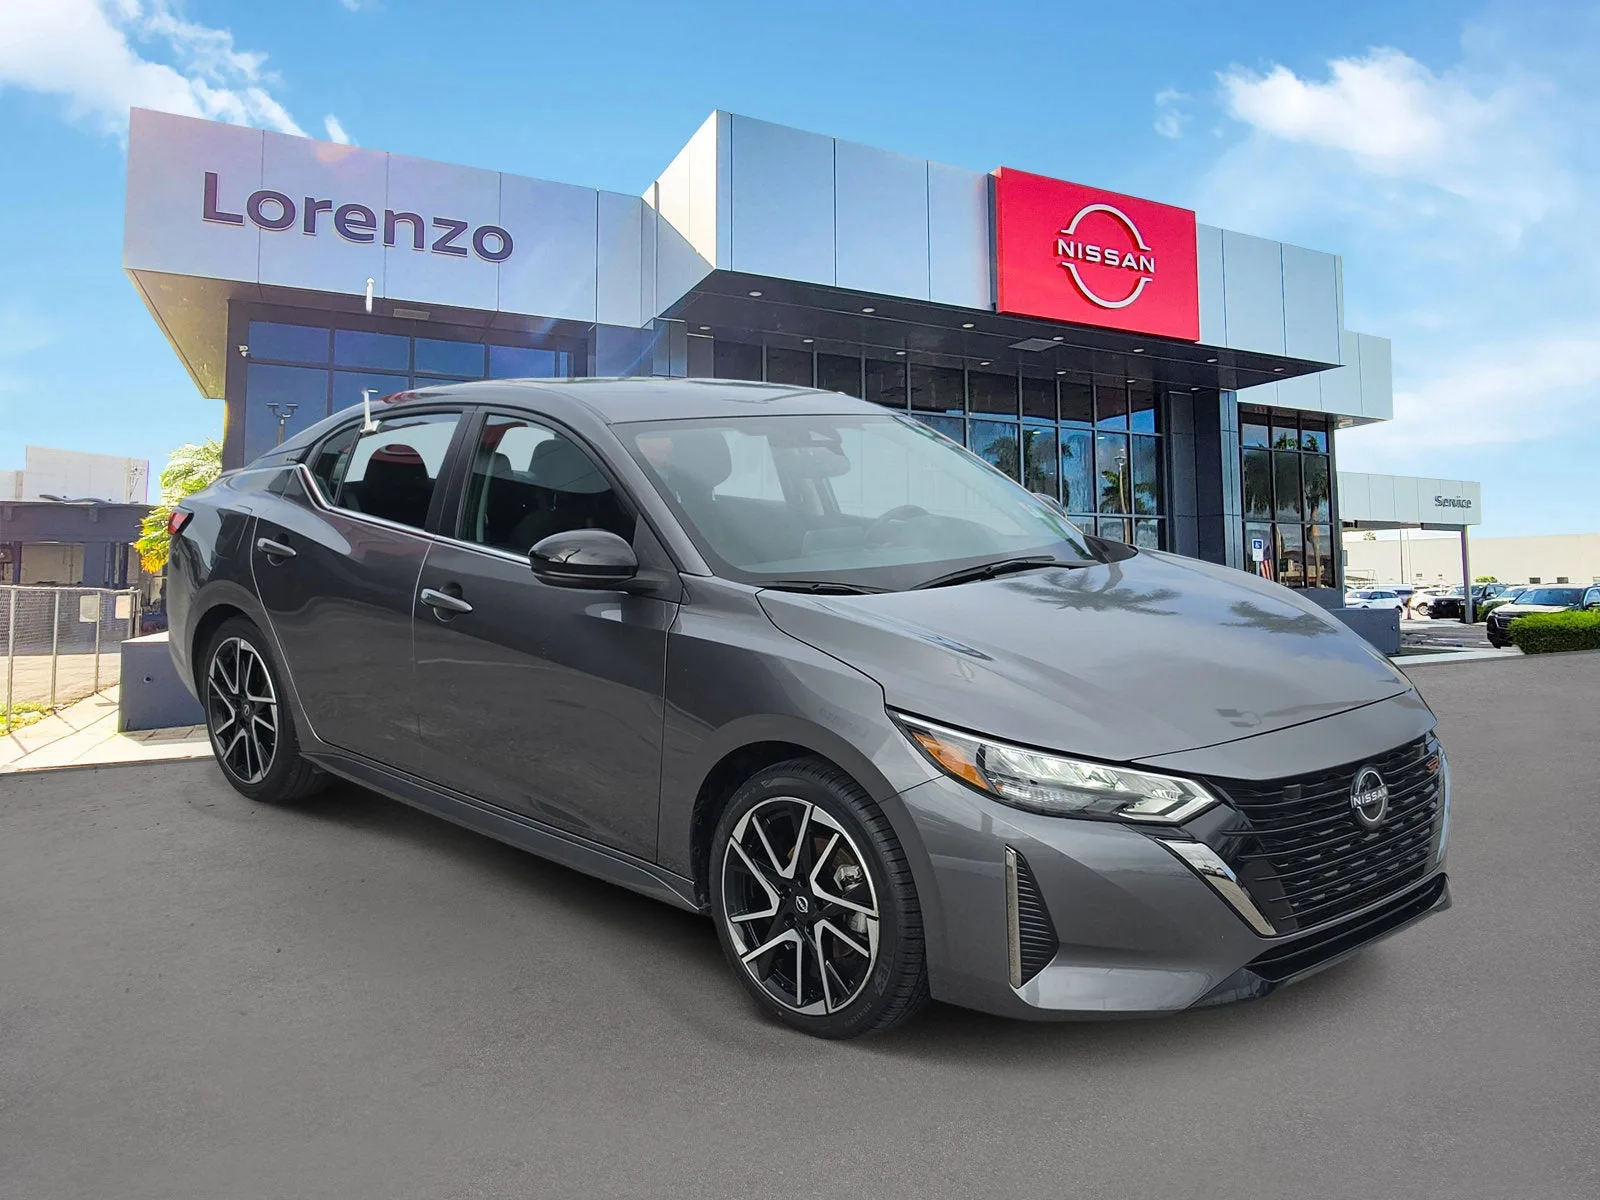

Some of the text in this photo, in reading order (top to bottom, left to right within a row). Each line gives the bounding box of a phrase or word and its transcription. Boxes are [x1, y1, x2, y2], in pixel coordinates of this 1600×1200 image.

[201, 170, 514, 262] Lorenzo
[1057, 238, 1155, 273] NISSAN
[1434, 495, 1472, 508] Service
[1353, 785, 1388, 807] NISSAN
